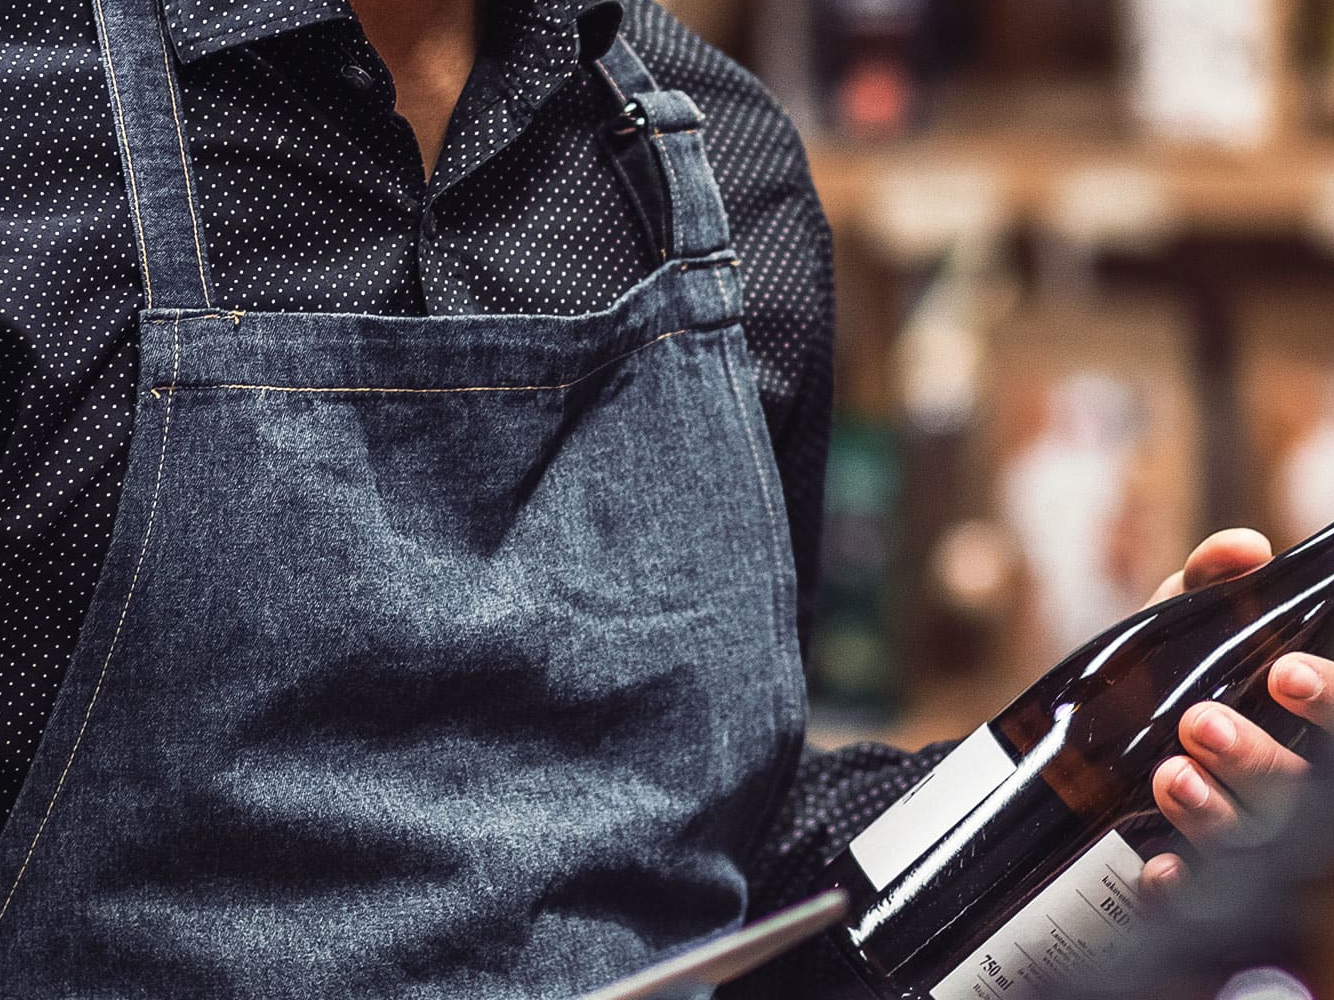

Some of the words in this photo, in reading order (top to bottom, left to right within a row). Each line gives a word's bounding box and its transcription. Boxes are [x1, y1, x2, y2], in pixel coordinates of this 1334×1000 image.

[1100, 896, 1133, 931] BRD
[979, 954, 1002, 977] 750
[994, 975, 1014, 991] ml
